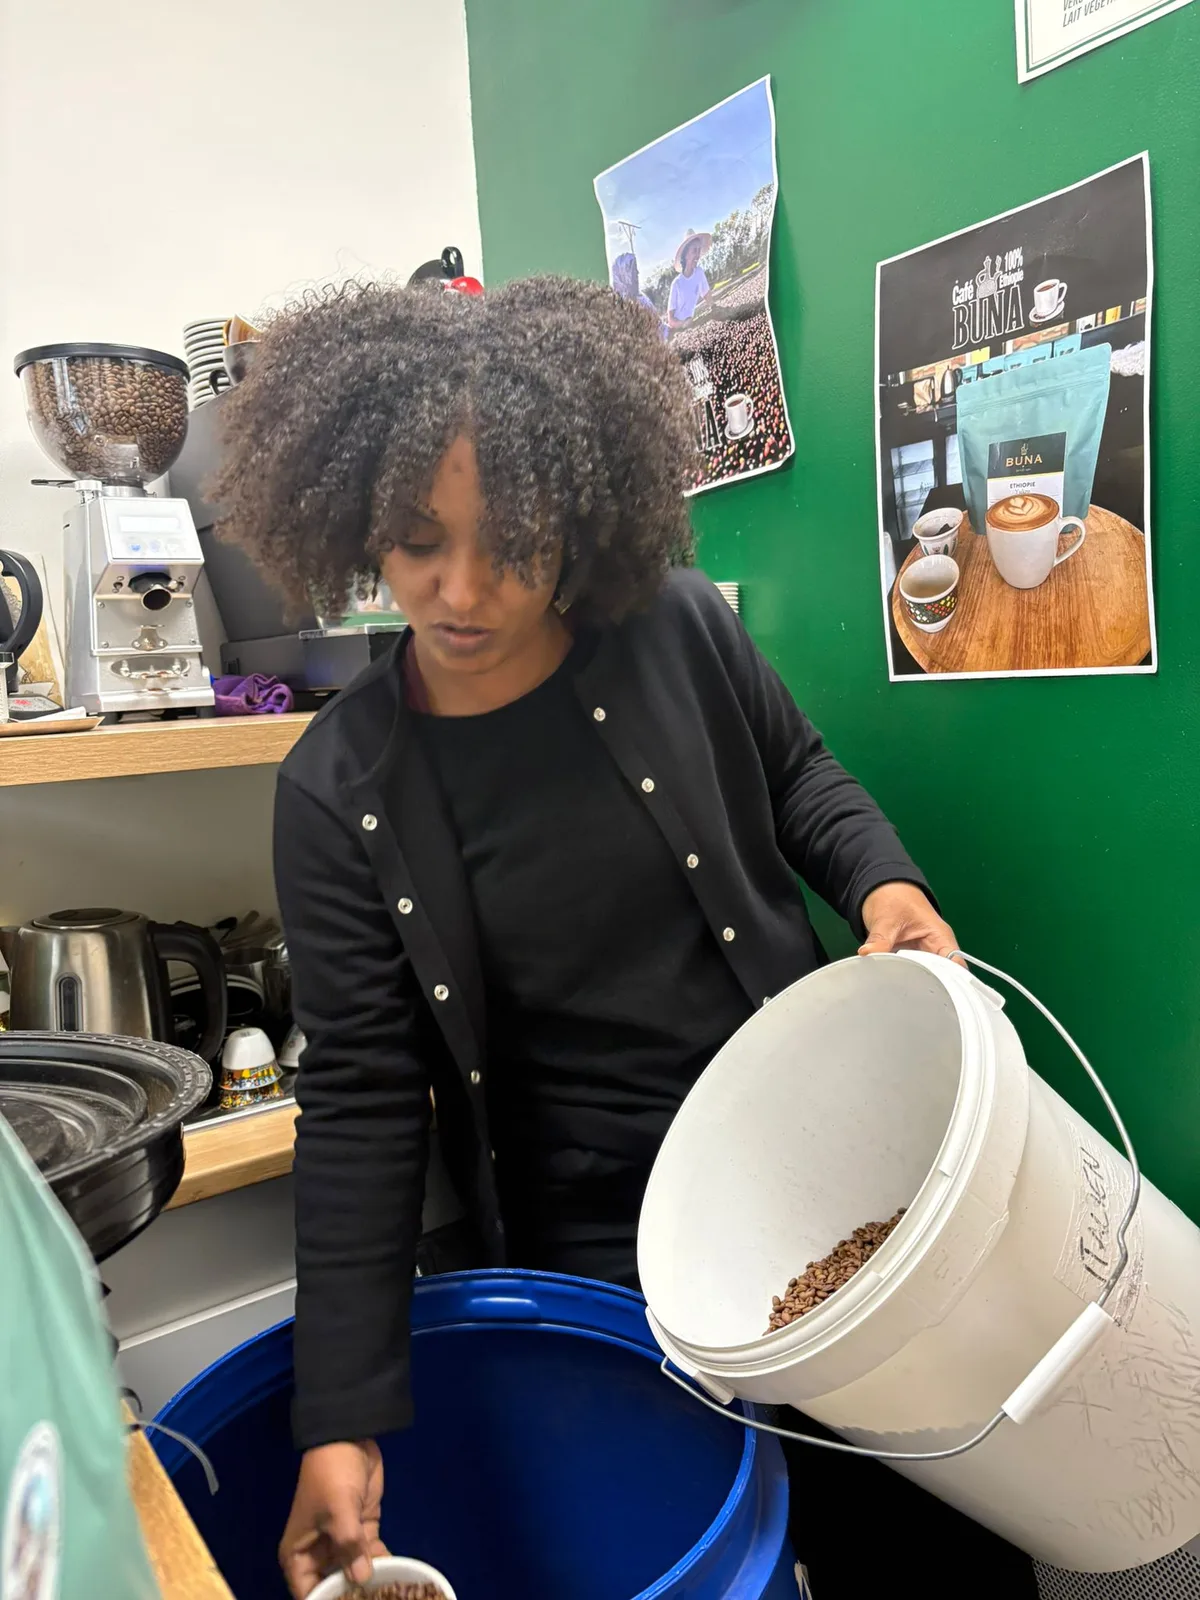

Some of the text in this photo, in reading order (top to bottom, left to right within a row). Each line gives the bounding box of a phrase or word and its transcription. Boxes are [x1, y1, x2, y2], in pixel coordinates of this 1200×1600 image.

[1063, 6, 1082, 27] LAIT
[1005, 246, 1023, 271] 100%
[952, 269, 1024, 305] Café Ethiopie
[952, 285, 1025, 350] BUNA
[1005, 454, 1042, 467] BUNA
